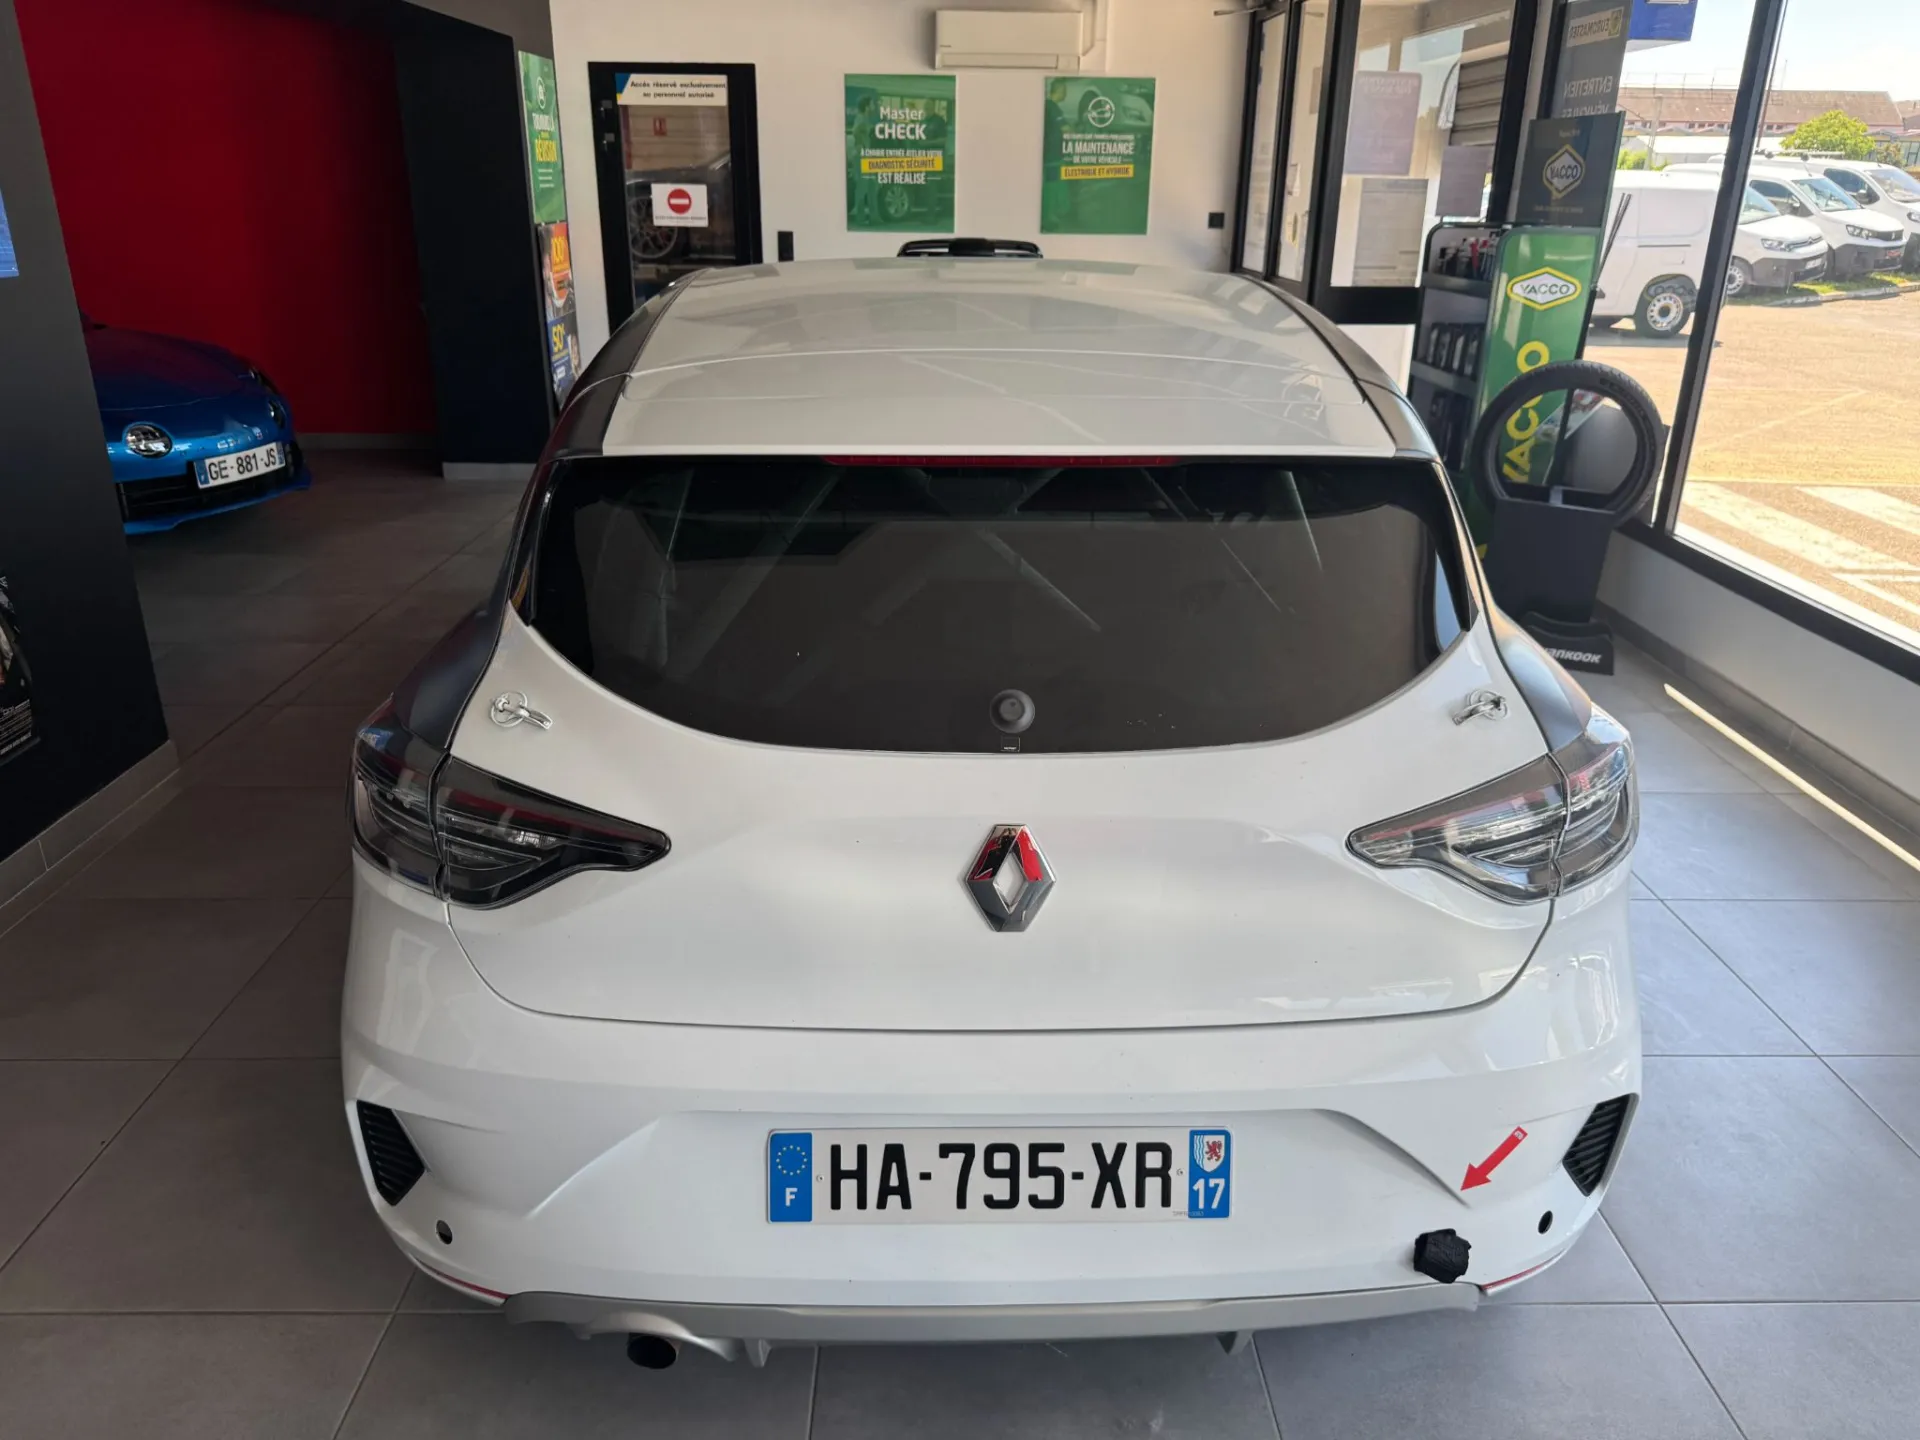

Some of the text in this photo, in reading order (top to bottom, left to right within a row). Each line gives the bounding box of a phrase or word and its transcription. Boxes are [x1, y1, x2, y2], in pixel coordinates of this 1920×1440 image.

[630, 80, 726, 89] Accès réservé exclusivement
[880, 106, 925, 120] Master
[875, 123, 926, 140] CHECK
[1062, 141, 1135, 155] LA MAINTENANCE
[868, 158, 935, 170] DIAGNOSTIC SÉCURITÉ
[878, 172, 893, 184] EST
[1549, 164, 1579, 180] YACCO
[1520, 282, 1571, 296] YACCO
[829, 1141, 1173, 1211] HA-795-XR
[785, 1187, 798, 1207] F
[1192, 1177, 1226, 1210] 17
